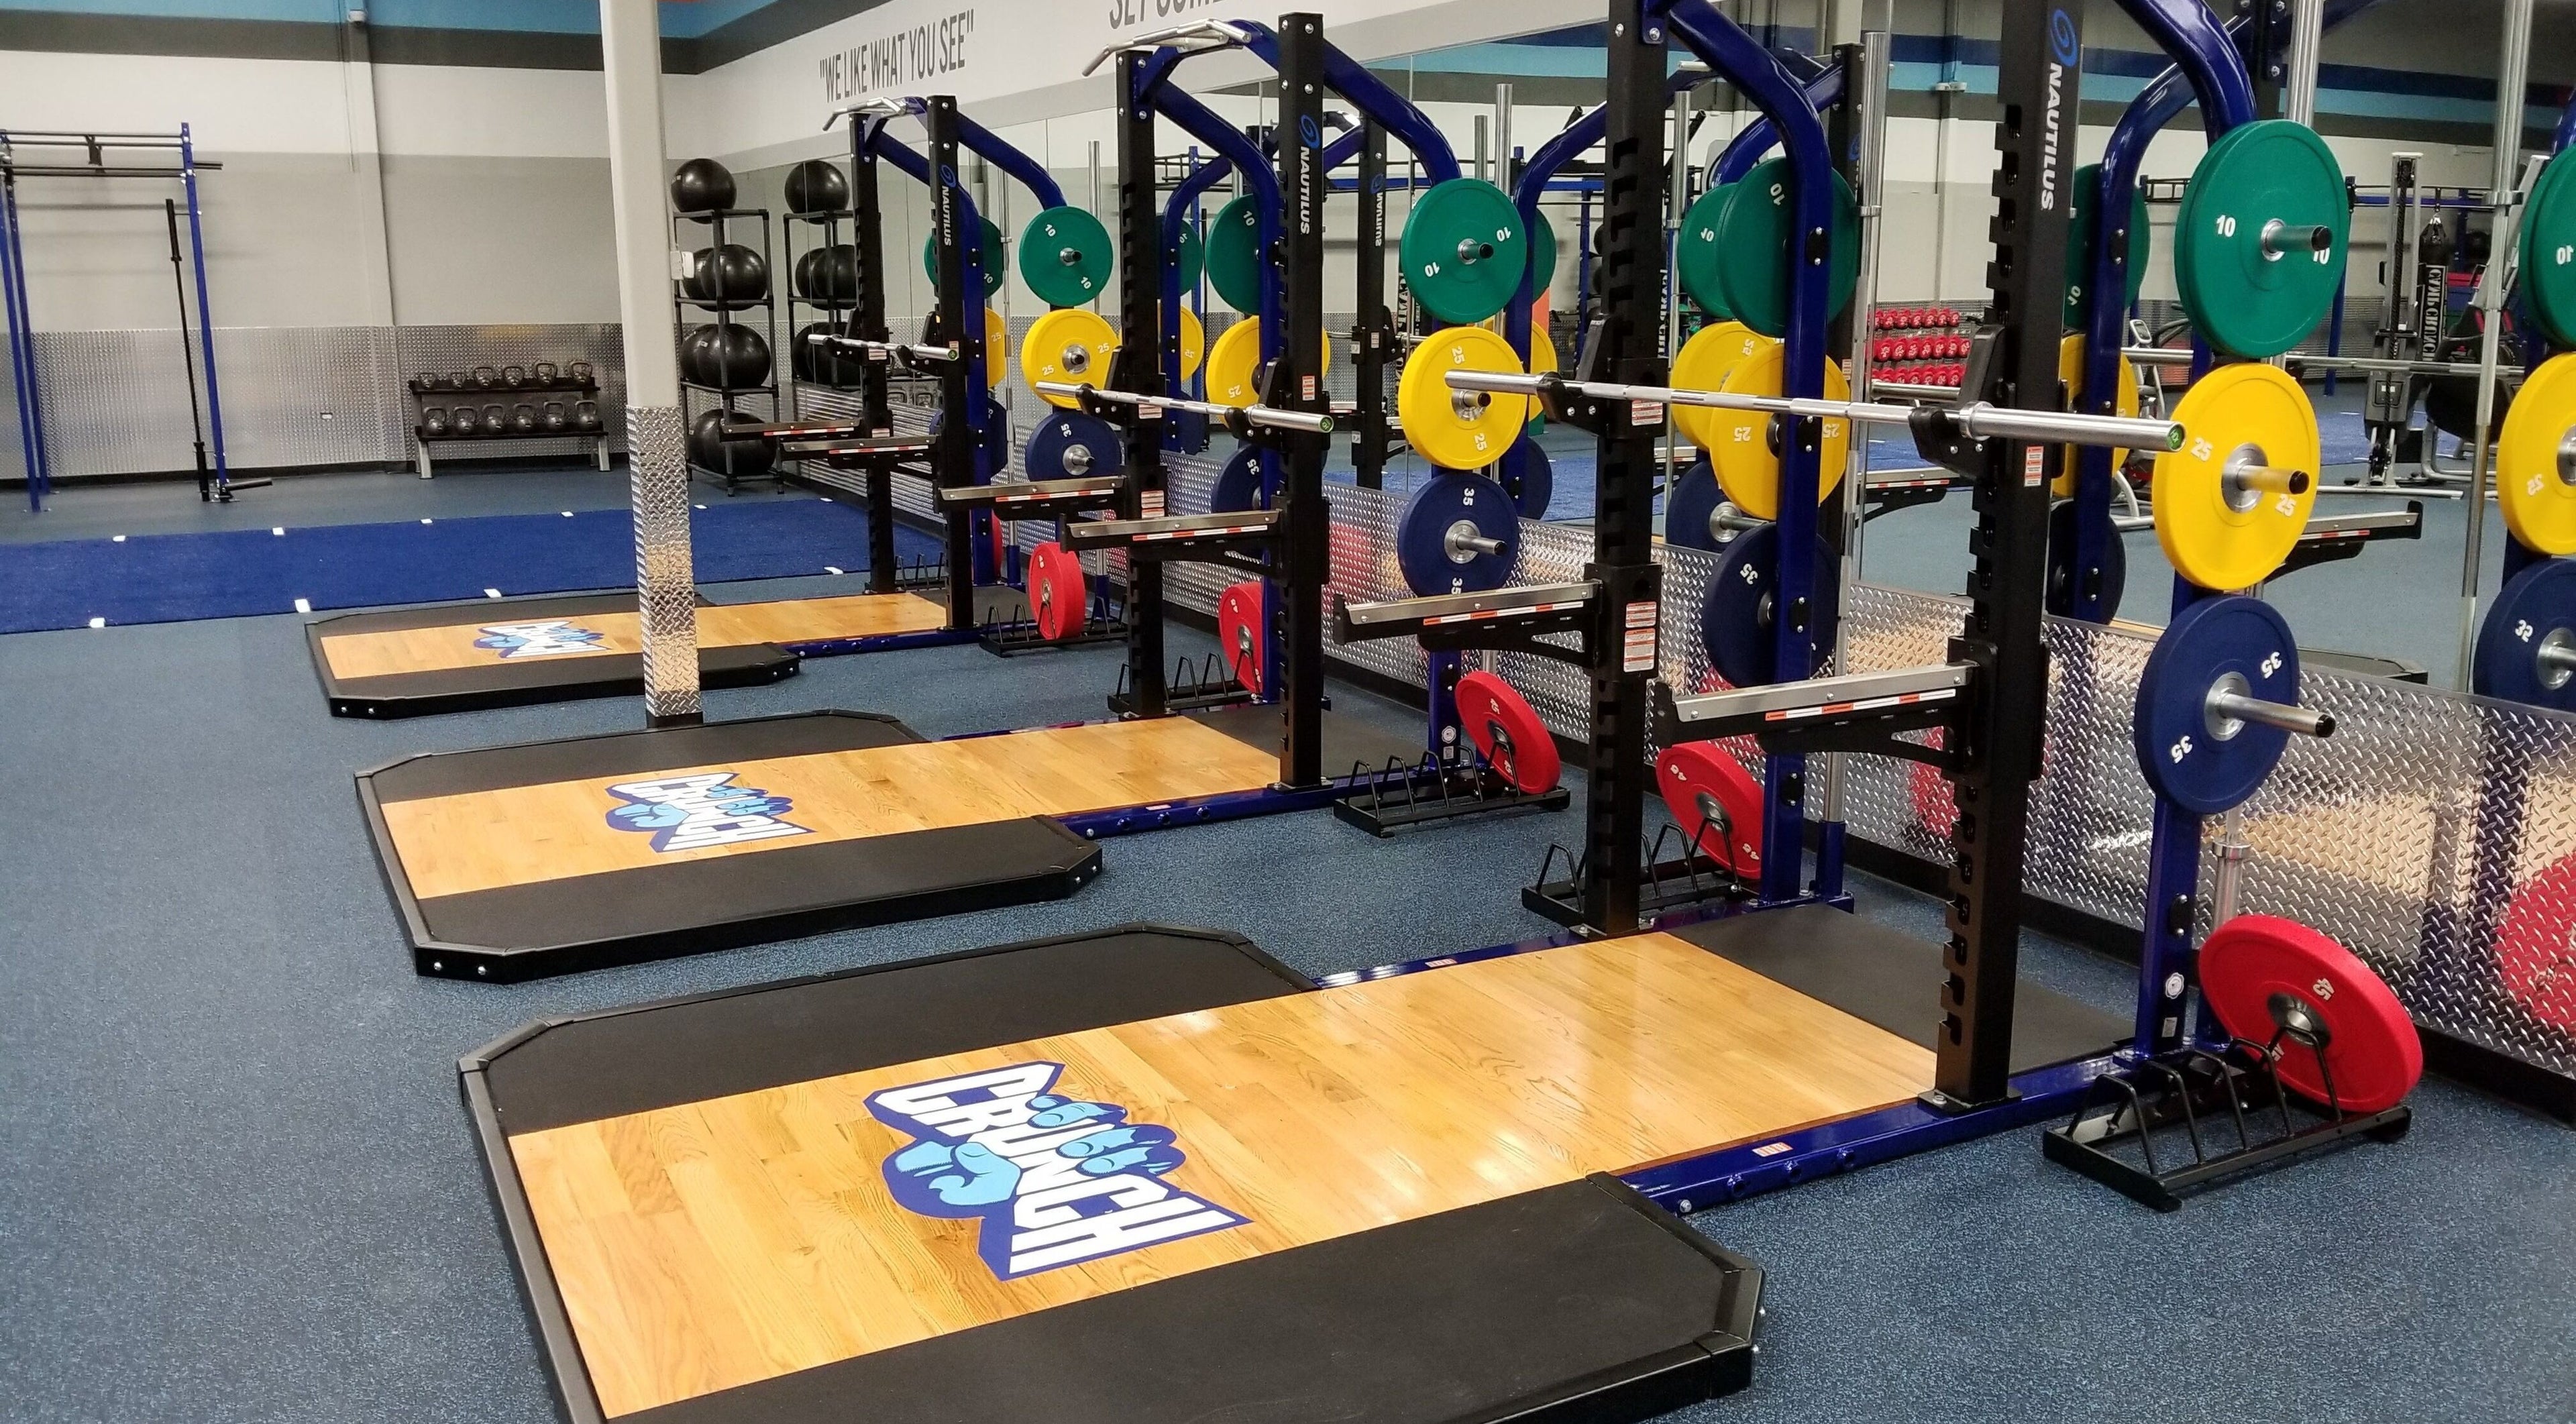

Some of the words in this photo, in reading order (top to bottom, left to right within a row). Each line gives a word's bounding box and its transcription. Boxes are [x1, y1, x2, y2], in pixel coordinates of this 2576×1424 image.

[820, 54, 841, 103] "WE
[844, 44, 867, 98] LIKE
[870, 32, 905, 90] WHAT
[908, 22, 935, 81] YOU
[939, 8, 974, 74] SEE"
[2041, 62, 2062, 211] NAUTILUS
[1300, 146, 1310, 235] NAUTILUS
[1770, 183, 1786, 206] 10
[941, 185, 951, 246] NAUTILUS
[1243, 211, 1255, 227] 10
[1045, 224, 1056, 237] 10
[1497, 227, 1511, 242] 10
[2216, 214, 2236, 237] 10
[983, 273, 994, 284] 10
[1424, 262, 1440, 277] 10
[1081, 276, 1092, 290] 10
[991, 333, 1002, 341] 25
[1097, 343, 1110, 353] 25
[1452, 346, 1464, 364] 25
[1042, 365, 1055, 376] 25
[1228, 384, 1242, 398] 25
[1061, 423, 1071, 437] 35
[1734, 427, 1752, 441] 25
[1823, 424, 1839, 438] 25
[1474, 433, 1487, 451] 25
[2190, 437, 2213, 462] 25
[1247, 459, 1259, 475] 35
[1462, 488, 1474, 506] 35
[2275, 494, 2297, 517] 25
[1740, 563, 1758, 584] 35
[1451, 578, 1463, 595] 35
[2261, 651, 2282, 679] 35
[2171, 735, 2193, 763] 35
[611, 773, 808, 851] CRUNCH
[2312, 978, 2334, 1001] 45
[873, 1064, 1236, 1274] CRUNCH
